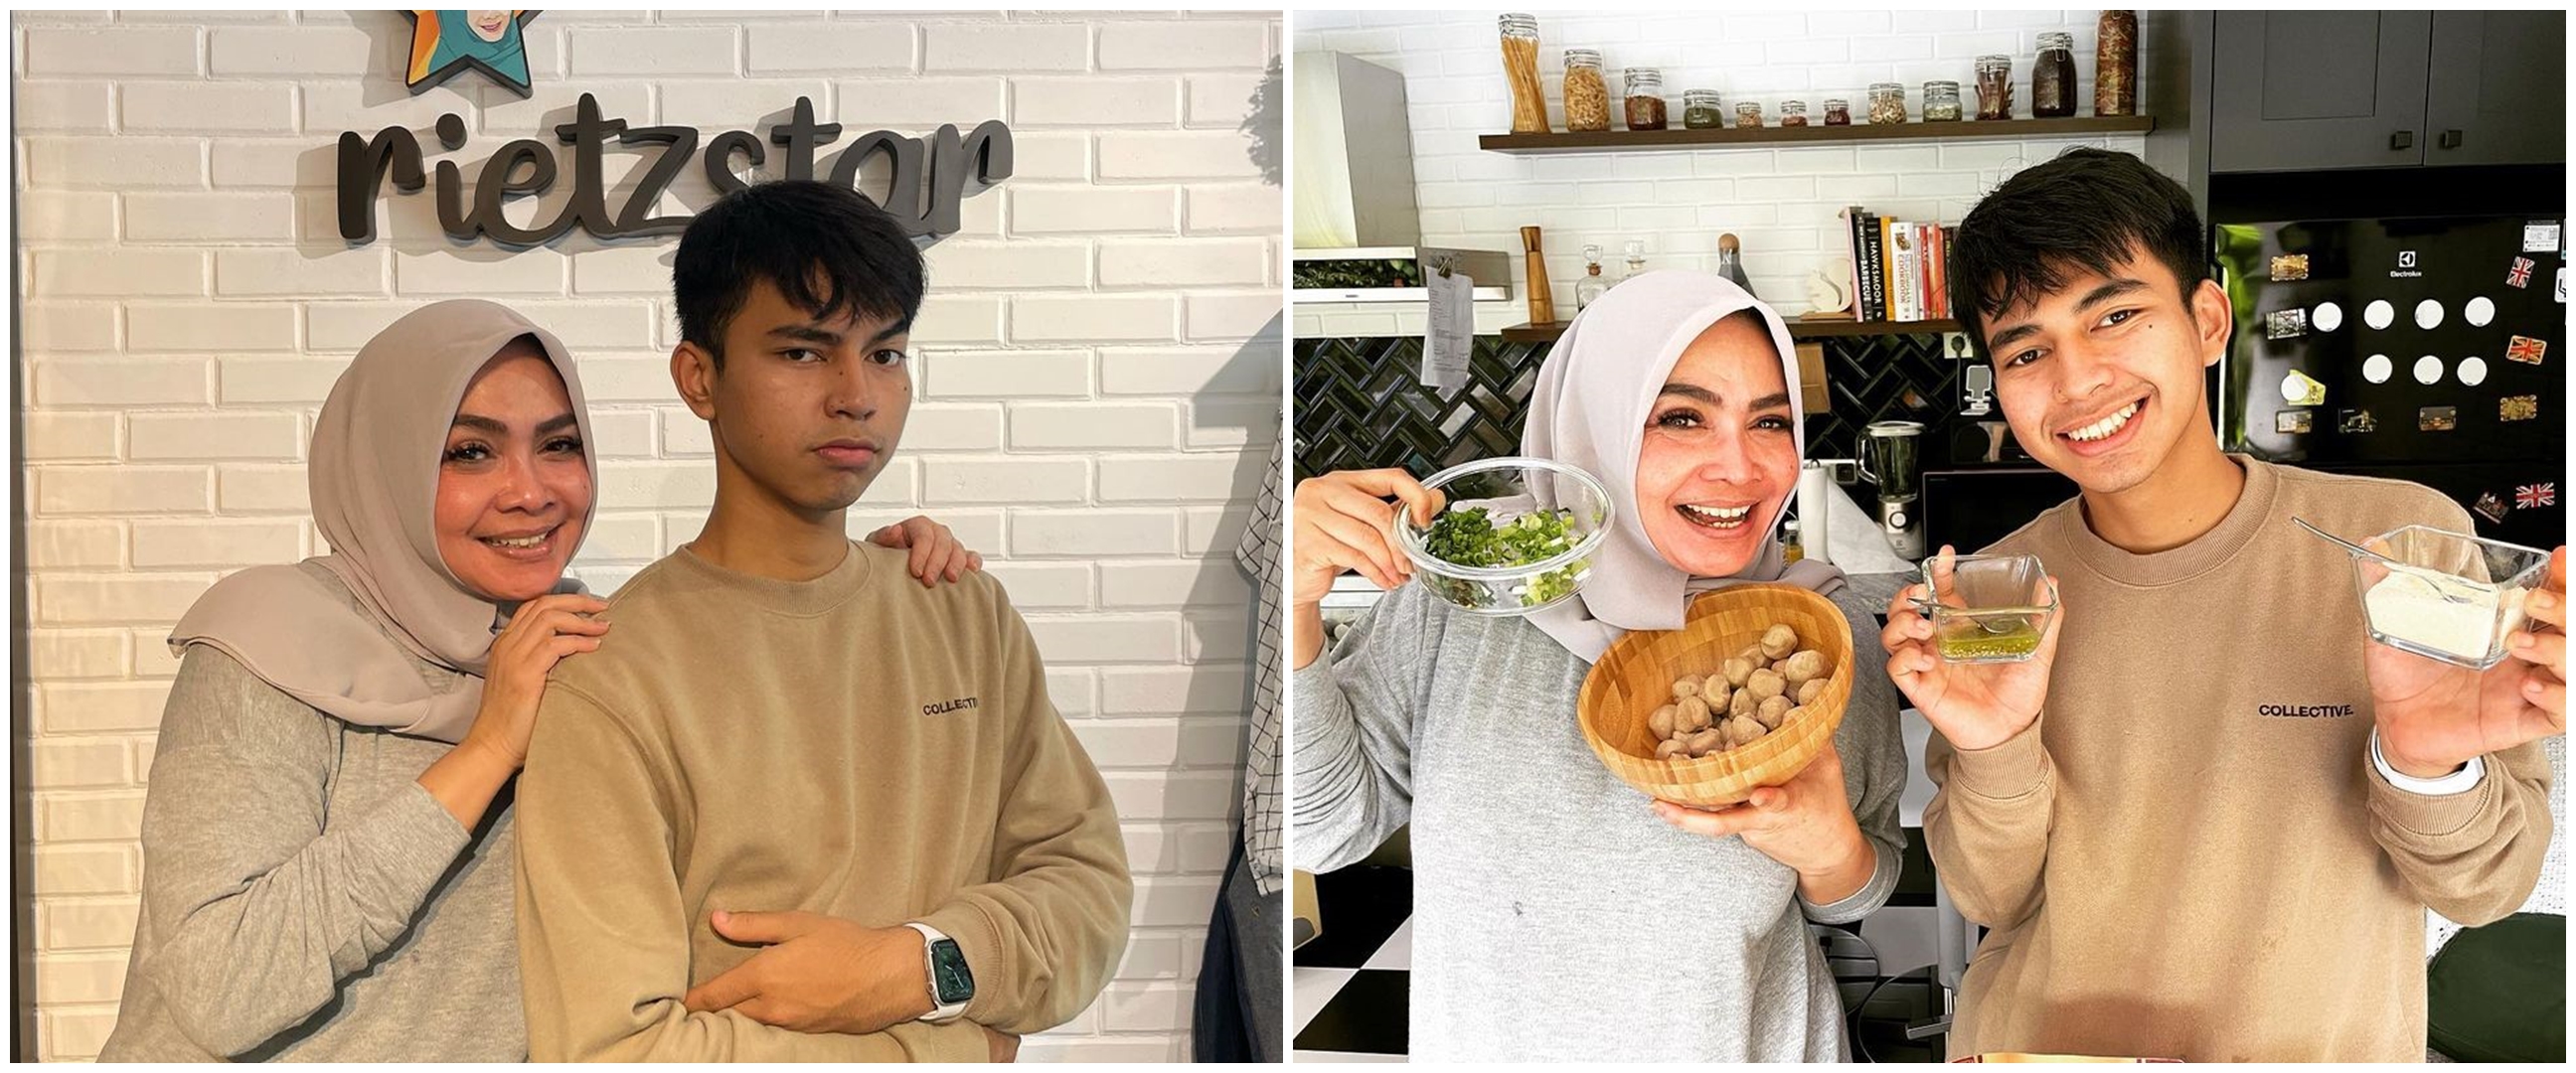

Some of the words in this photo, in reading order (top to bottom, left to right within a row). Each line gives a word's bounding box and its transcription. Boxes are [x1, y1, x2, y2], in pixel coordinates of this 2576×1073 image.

[337, 92, 1014, 247] rietzstar
[1860, 259, 1871, 301] BARBECUE
[1869, 241, 1882, 304] HAWKSMOOR
[922, 697, 978, 716] COLLECTI
